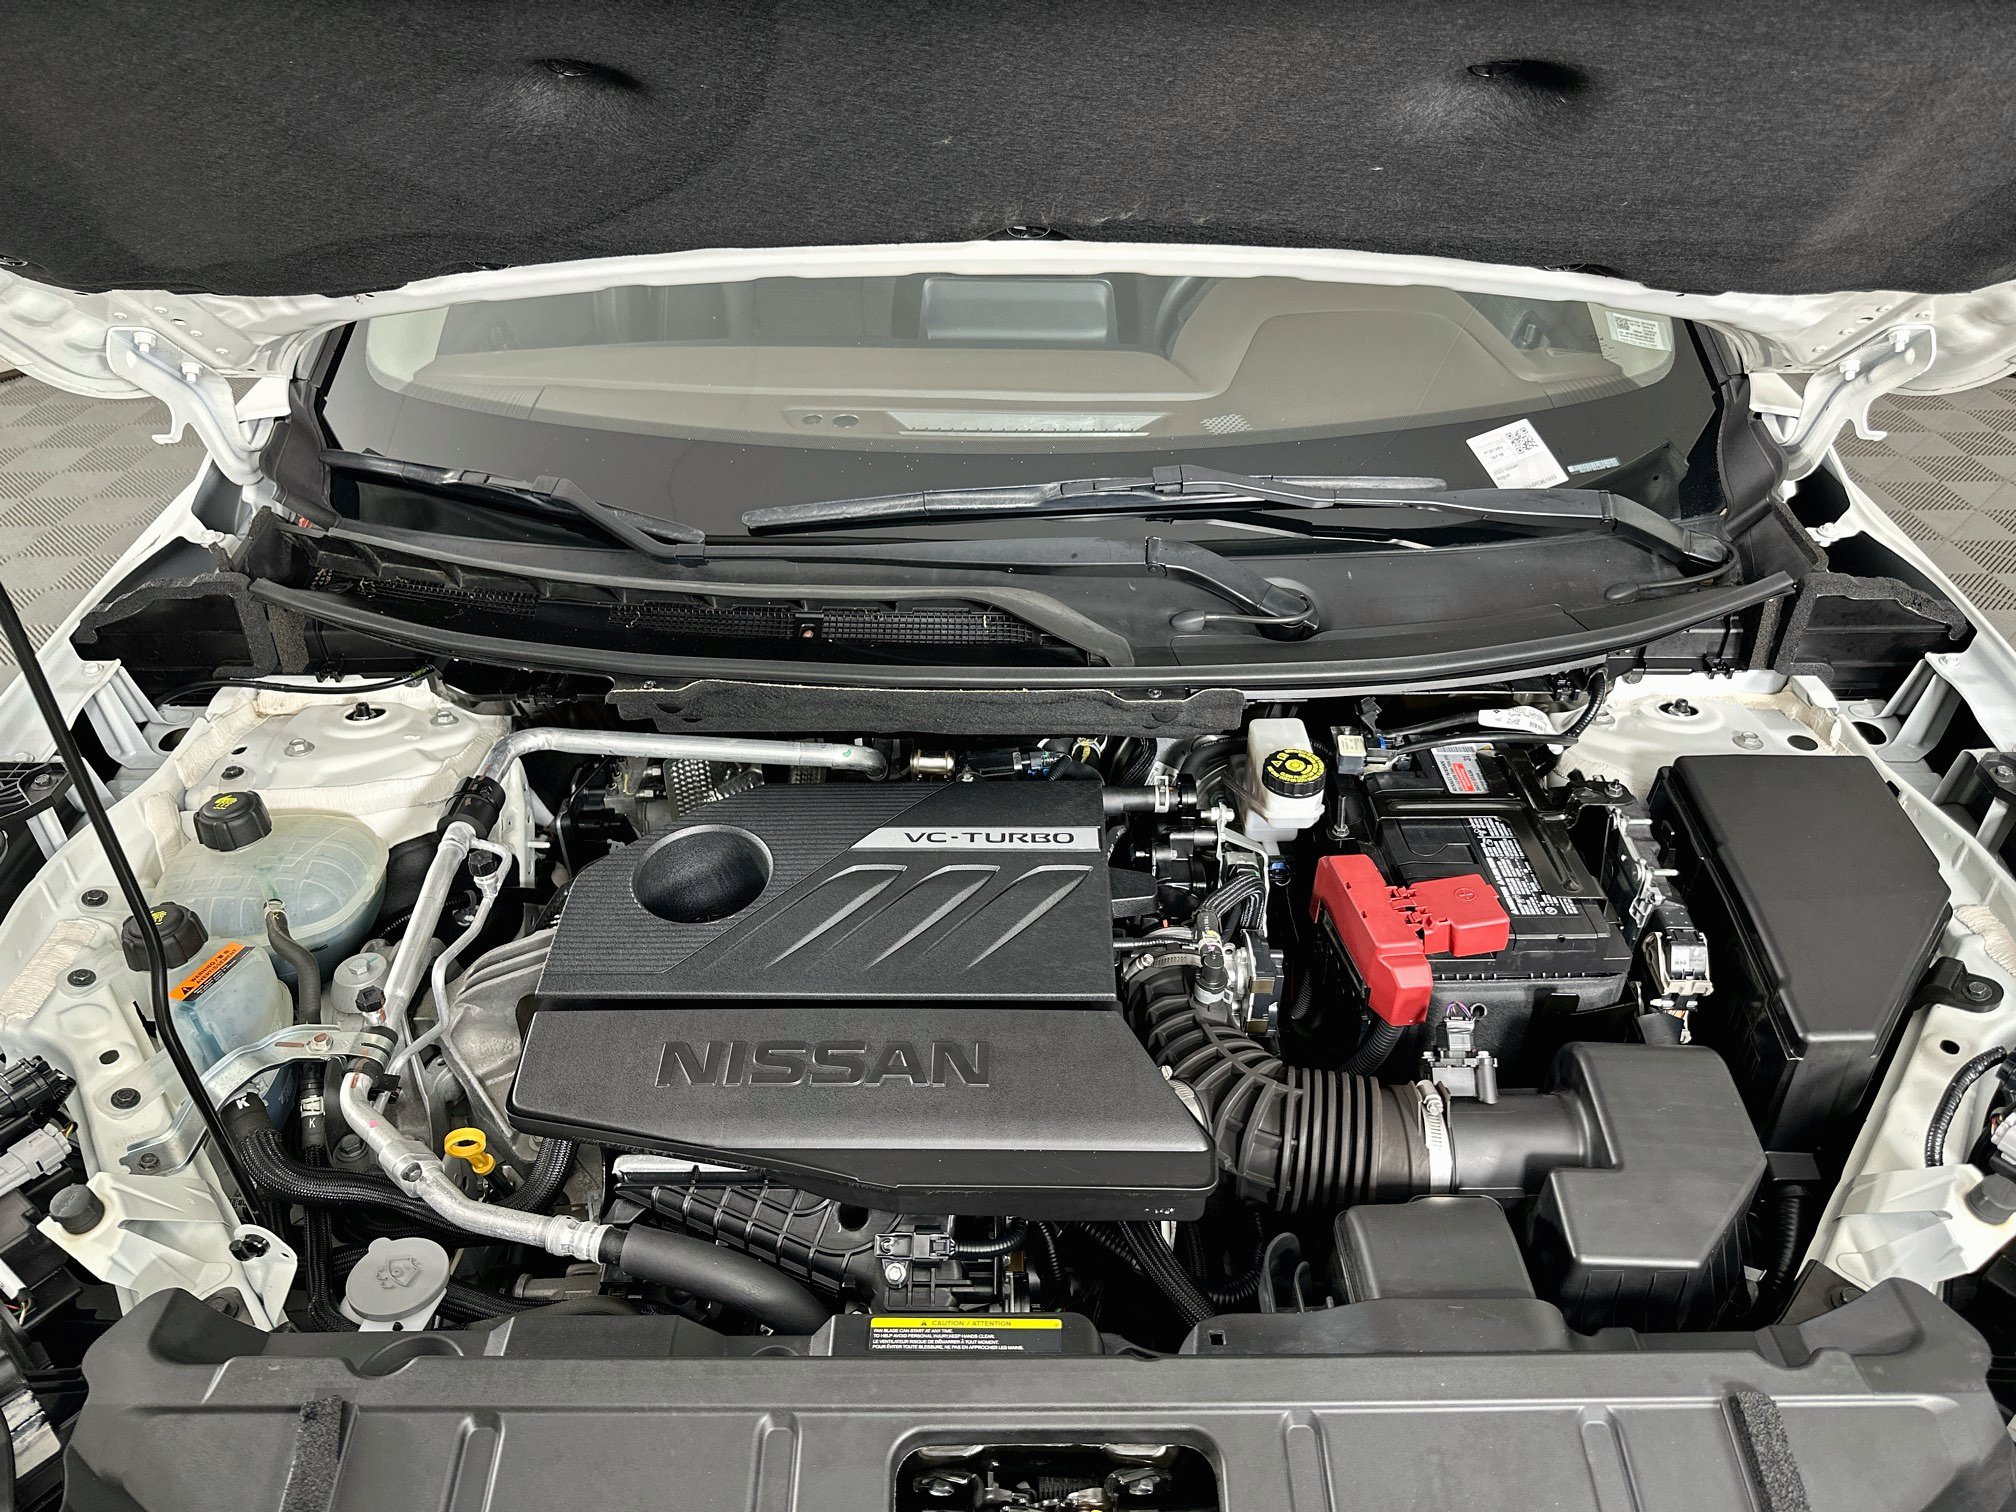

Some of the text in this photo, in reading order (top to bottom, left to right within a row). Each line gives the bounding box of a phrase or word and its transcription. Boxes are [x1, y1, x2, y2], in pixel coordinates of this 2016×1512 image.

[190, 961, 215, 982] WARNING
[196, 949, 237, 984] AVERTISSEMENT
[654, 1039, 991, 1089] NISSAN
[236, 1097, 250, 1110] K
[309, 1117, 315, 1128] K
